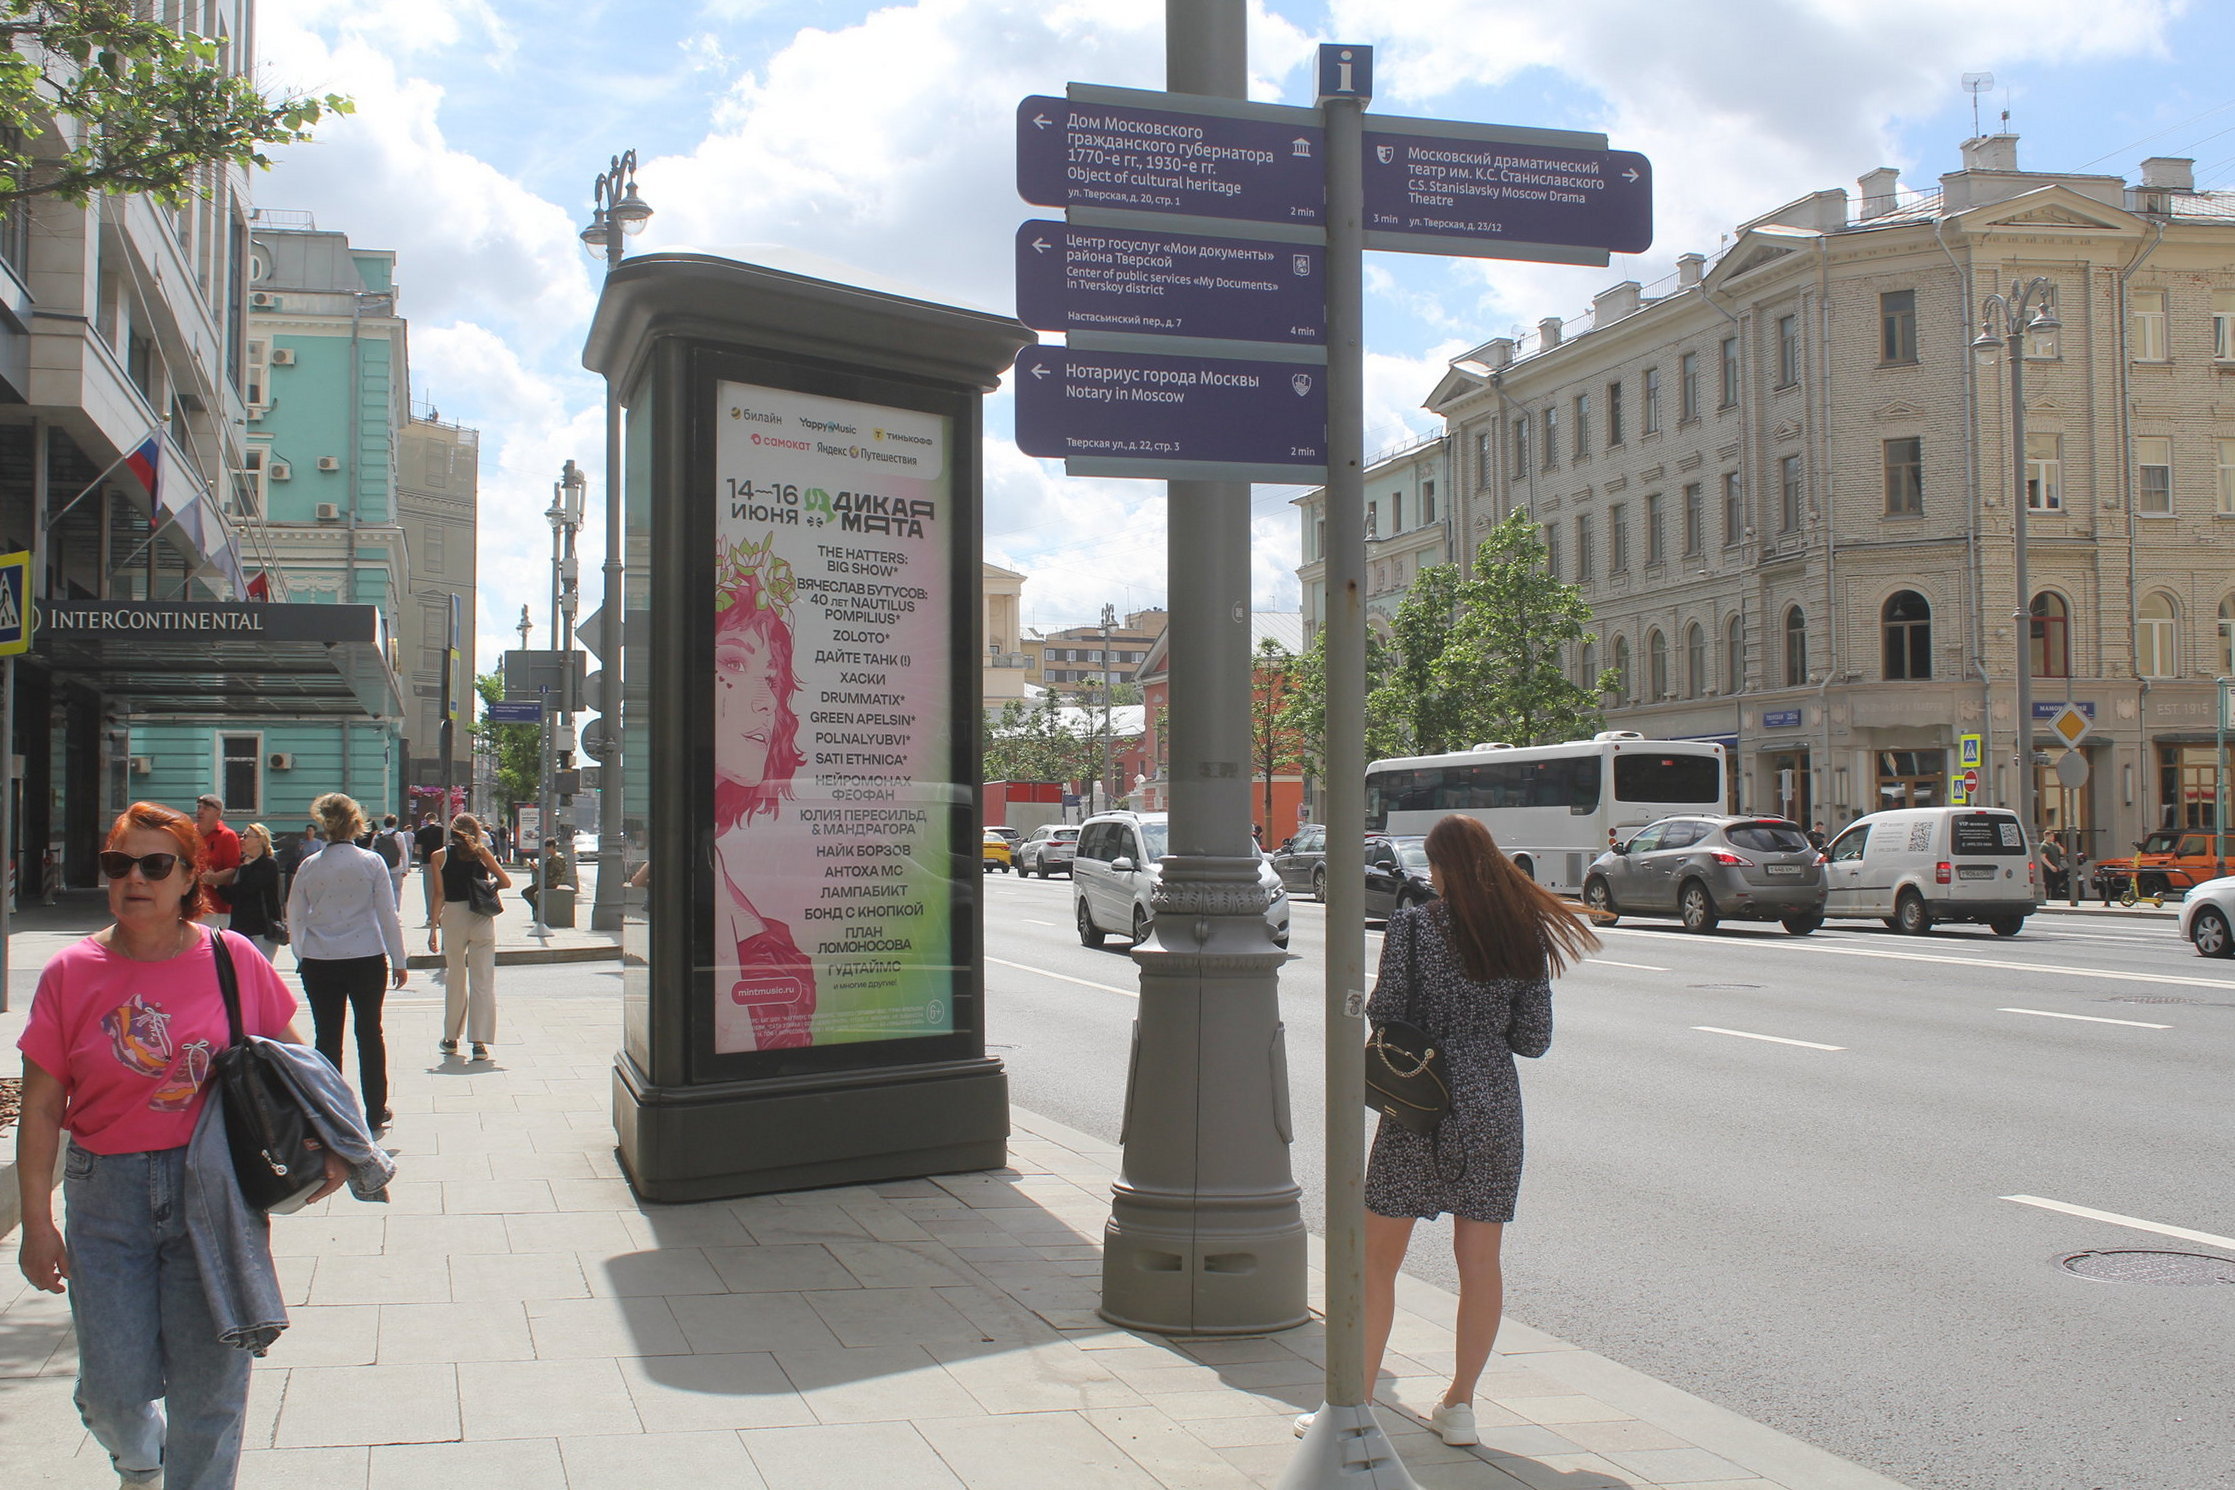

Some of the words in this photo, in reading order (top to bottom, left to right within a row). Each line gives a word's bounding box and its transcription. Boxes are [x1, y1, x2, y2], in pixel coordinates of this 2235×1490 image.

[1067, 113, 1101, 130] Дом
[1105, 116, 1204, 139] Московского
[1067, 132, 1176, 154] гражданского
[1179, 143, 1274, 165] губернатора
[1068, 149, 1121, 166] 1770-е
[1124, 155, 1144, 170] гг.,
[1146, 156, 1198, 174] 1930-е
[1201, 162, 1217, 175] гг.
[1408, 147, 1491, 165] Московский
[1494, 153, 1600, 174] драматический
[1067, 166, 1112, 184] Object
[1114, 171, 1129, 184] of
[1131, 173, 1184, 190] cultural
[1186, 177, 1242, 196] heritage
[1408, 164, 1446, 180] театр
[1449, 166, 1472, 180] им.
[1475, 167, 1498, 181] К.С.
[1500, 171, 1605, 191] Станиславского
[1068, 189, 1082, 200] ул.
[1083, 189, 1129, 203] Тверская,
[1130, 194, 1139, 203] д.
[1141, 194, 1154, 205] 20,
[1155, 197, 1173, 207] стр.
[1175, 197, 1180, 206] 1
[1408, 179, 1427, 192] C.S.
[1430, 180, 1500, 199] Stanislavsky
[1502, 187, 1547, 201] Moscow
[1549, 191, 1586, 204] Drama
[1408, 192, 1454, 206] Theatre
[1290, 207, 1296, 216] 2
[1297, 207, 1315, 217] min
[1373, 214, 1379, 224] 3
[1381, 213, 1398, 225] min
[1409, 216, 1423, 228] ул.
[1424, 218, 1465, 231] Тверская,
[1466, 221, 1476, 231] д.
[1477, 221, 1503, 233] 23/12
[1066, 234, 1106, 251] Центр
[1109, 239, 1161, 254] госуслуг
[1163, 242, 1197, 256] «Мои
[1200, 245, 1276, 262] документы»
[1066, 250, 1114, 264] района
[1116, 253, 1173, 269] Тверской
[1066, 266, 1101, 278] Center
[1103, 268, 1114, 279] of
[1116, 269, 1149, 284] public
[1150, 273, 1192, 286] services
[1193, 275, 1215, 289] «My
[1217, 278, 1279, 292] Documents»
[1067, 279, 1077, 289] in
[1079, 279, 1124, 295] Tverskoy
[1125, 282, 1165, 296] district
[1068, 311, 1141, 325] Настасьинский
[1143, 316, 1165, 329] пер.,
[1165, 318, 1175, 328] д.
[1176, 318, 1182, 327] 7
[1290, 326, 1296, 335] 4
[1298, 326, 1315, 336] min
[1066, 363, 1140, 383] Нотариус
[1143, 369, 1197, 385] города
[1200, 372, 1260, 388] Москвы
[1066, 385, 1113, 403] Notary
[1116, 386, 1129, 399] in
[1131, 388, 1185, 403] Moscow
[744, 409, 782, 425] билайн
[764, 437, 811, 451] самокат
[886, 432, 933, 446] тинькофф
[1066, 437, 1110, 450] Тверская
[1112, 439, 1127, 451] ул.,
[1128, 440, 1138, 451] д.
[1139, 440, 1153, 452] 22,
[1154, 442, 1172, 453] стр.
[1174, 441, 1180, 451] 3
[817, 442, 847, 456] Яндекс
[861, 448, 917, 466] Путешествия
[1291, 446, 1297, 456] 2
[1298, 446, 1315, 456] min
[732, 503, 799, 525] ИЮНЯ
[833, 491, 935, 520] ДИКАЯ
[841, 512, 924, 539] МЯТА
[817, 545, 843, 559] THE
[845, 547, 909, 565] HATTERS:
[827, 560, 849, 573] BIG
[797, 578, 866, 595] ВЯЧЕСЛАВ
[867, 584, 928, 600] БУТУСОВ:
[810, 593, 829, 606] 40
[830, 597, 850, 608] ЛЕТ
[851, 596, 916, 612] NAUTILUS
[815, 648, 861, 664] ДАЙТЕ
[863, 652, 898, 667] ТАНК
[900, 654, 911, 667] (!)
[840, 672, 886, 685] ХАСКИ
[810, 711, 854, 725] GREEN
[816, 752, 844, 765] SATI
[815, 772, 912, 787] НЕЙРОМОНАХ
[832, 788, 895, 801] ФЕОФАН
[800, 809, 841, 822] ЮЛИЯ
[844, 809, 927, 823] ПЕРЕСИЛЬД
[812, 823, 821, 834] &
[823, 823, 916, 837] МАНДРАГОРА
[816, 842, 855, 857] НАЙК
[857, 844, 911, 857] БОРЗОВ
[824, 865, 880, 878] АНТОХА
[820, 884, 908, 899] ЛАМПАБИКТ
[804, 907, 844, 921] БОНД
[846, 907, 855, 919] С
[857, 901, 924, 918] КНОПКОЙ
[845, 926, 883, 939] ПЛАН
[817, 938, 912, 955] ЛОМОНОСОВА
[828, 959, 902, 977] ГУДТАЙМС
[738, 986, 795, 997] mintmusic.ru
[839, 981, 867, 990] многие
